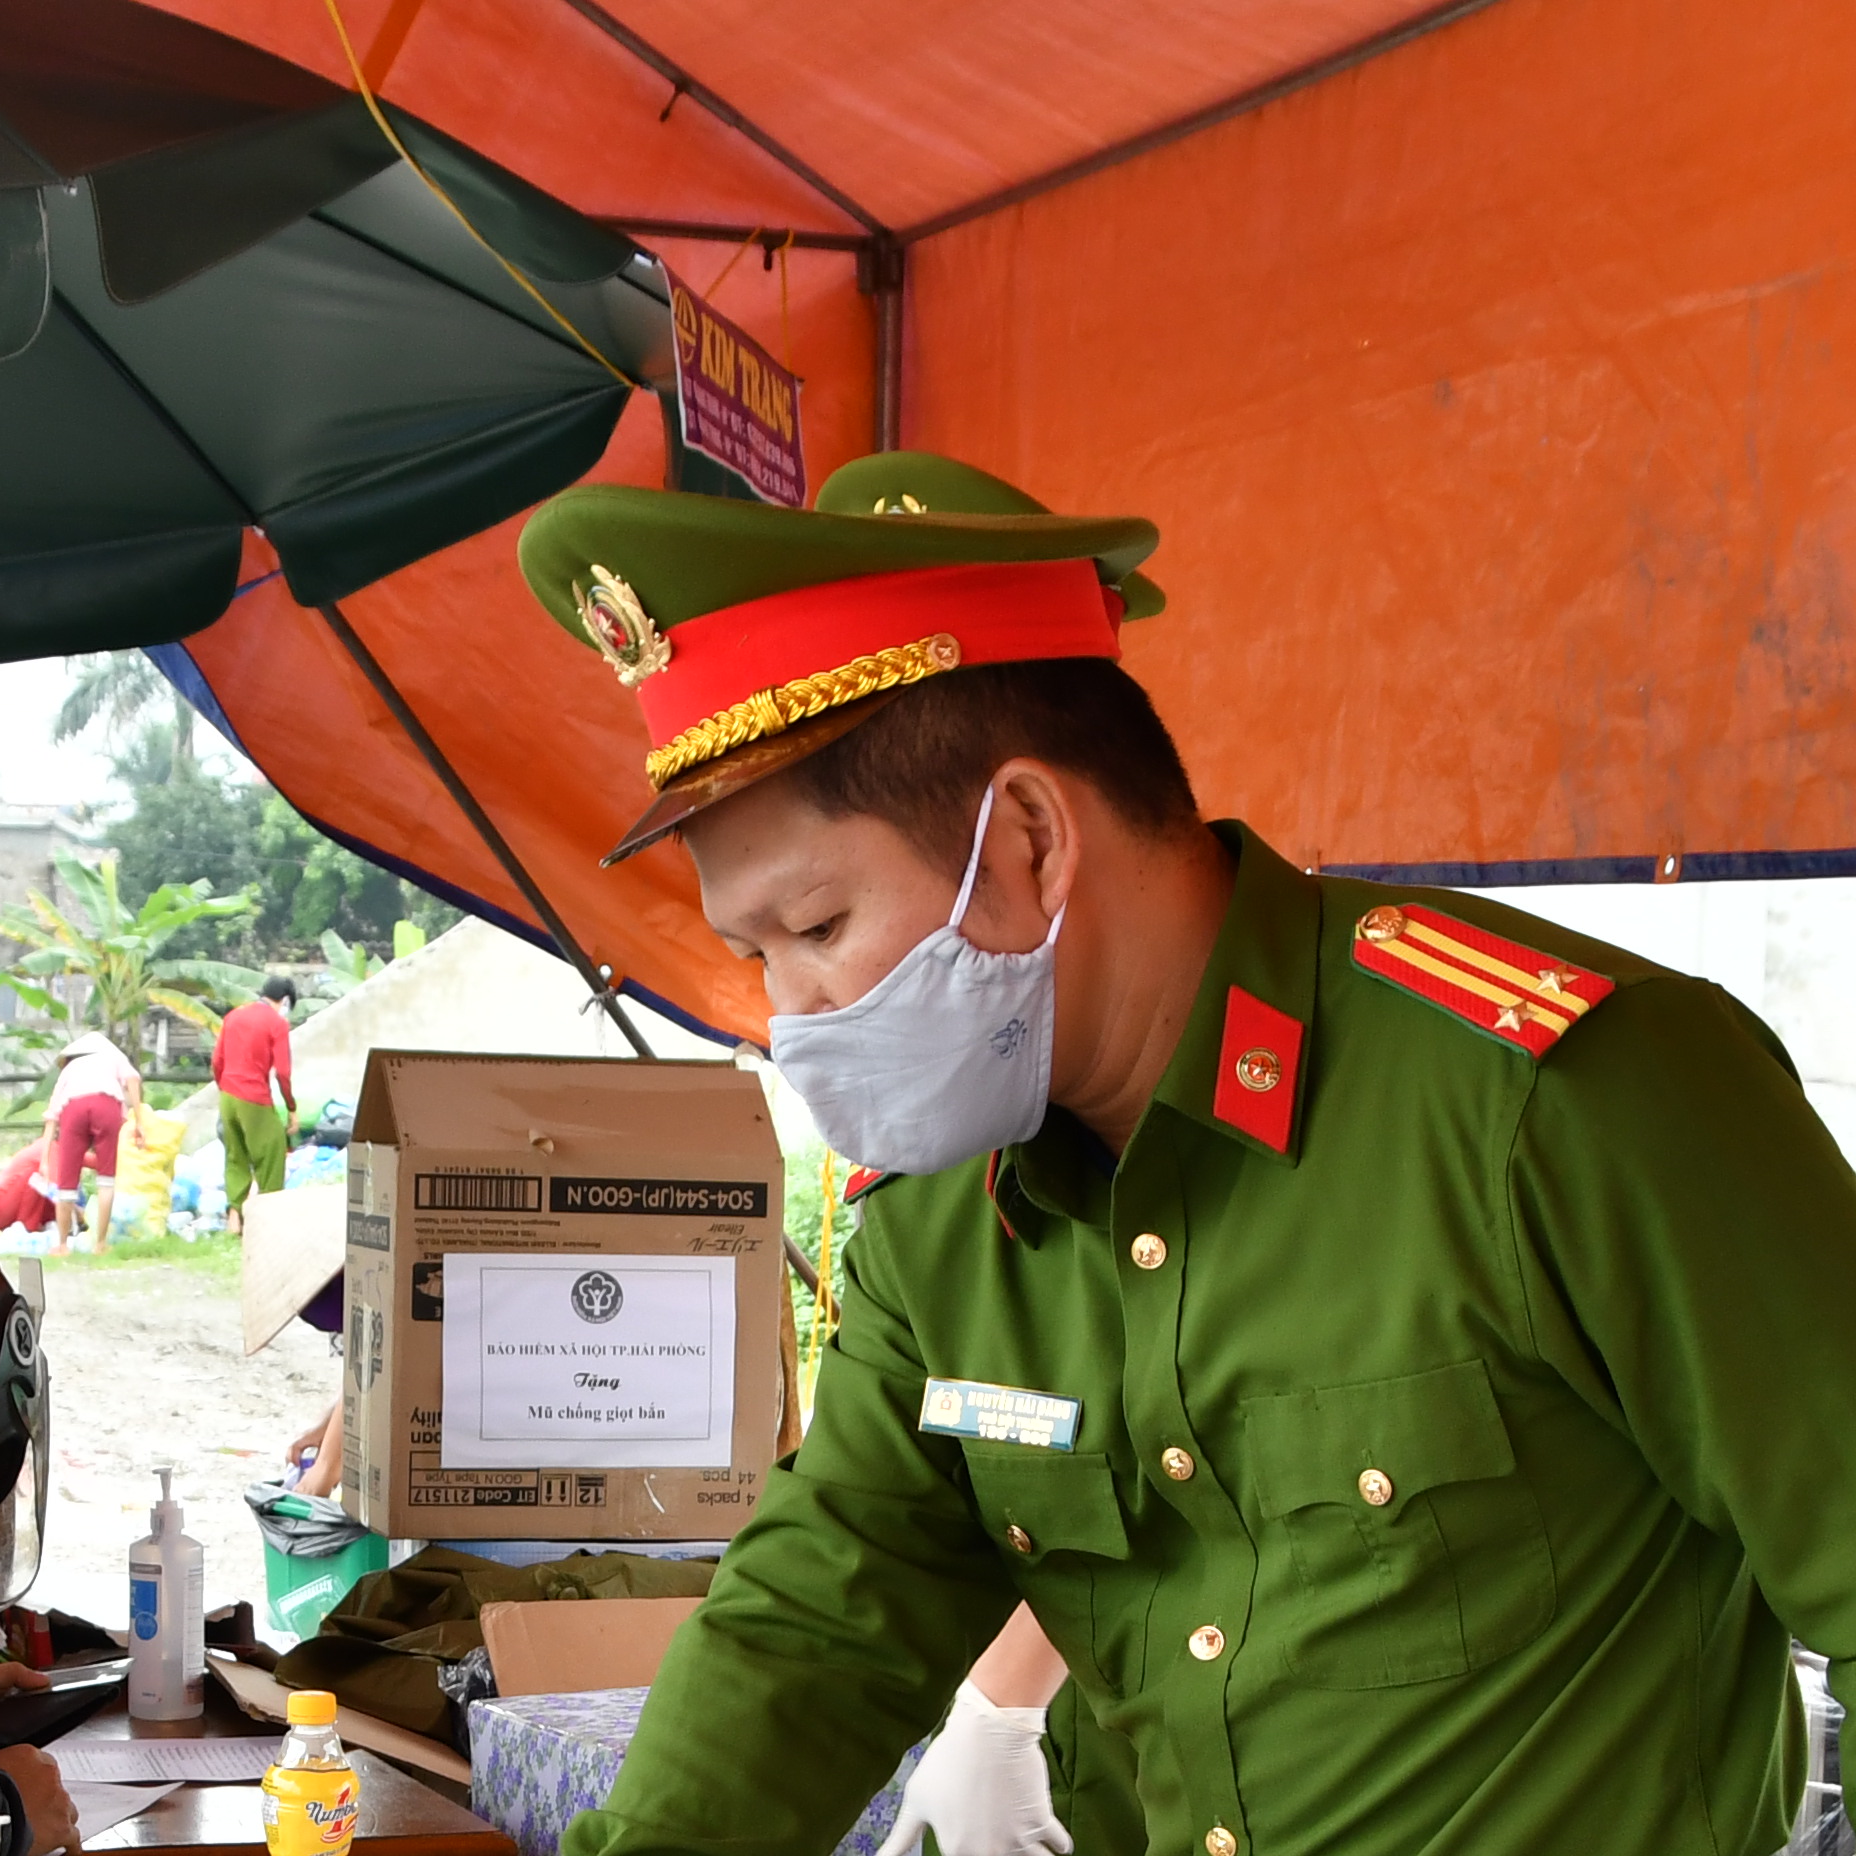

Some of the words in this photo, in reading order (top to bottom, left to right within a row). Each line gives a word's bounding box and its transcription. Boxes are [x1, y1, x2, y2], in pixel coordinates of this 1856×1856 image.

[701, 312, 735, 397] KIM
[738, 343, 793, 445] TRANG
[567, 1184, 754, 1210] SO4-S44(JP)-GOO.N
[559, 1341, 578, 1356] XÃ
[581, 1343, 607, 1358] HỘI
[658, 1342, 707, 1357] PHÒNG
[573, 1371, 622, 1391] Tặng
[528, 1405, 553, 1420] Mũ
[558, 1402, 601, 1423] chống
[606, 1405, 635, 1423] giọt
[639, 1402, 665, 1420] bắn
[425, 1472, 452, 1485] Type
[454, 1472, 481, 1485] Tape
[737, 1471, 756, 1484] 44
[413, 1488, 470, 1503] 211517
[476, 1489, 512, 1503] Code
[579, 1488, 603, 1503] 12
[697, 1489, 740, 1506] packs
[745, 1492, 756, 1506] 4
